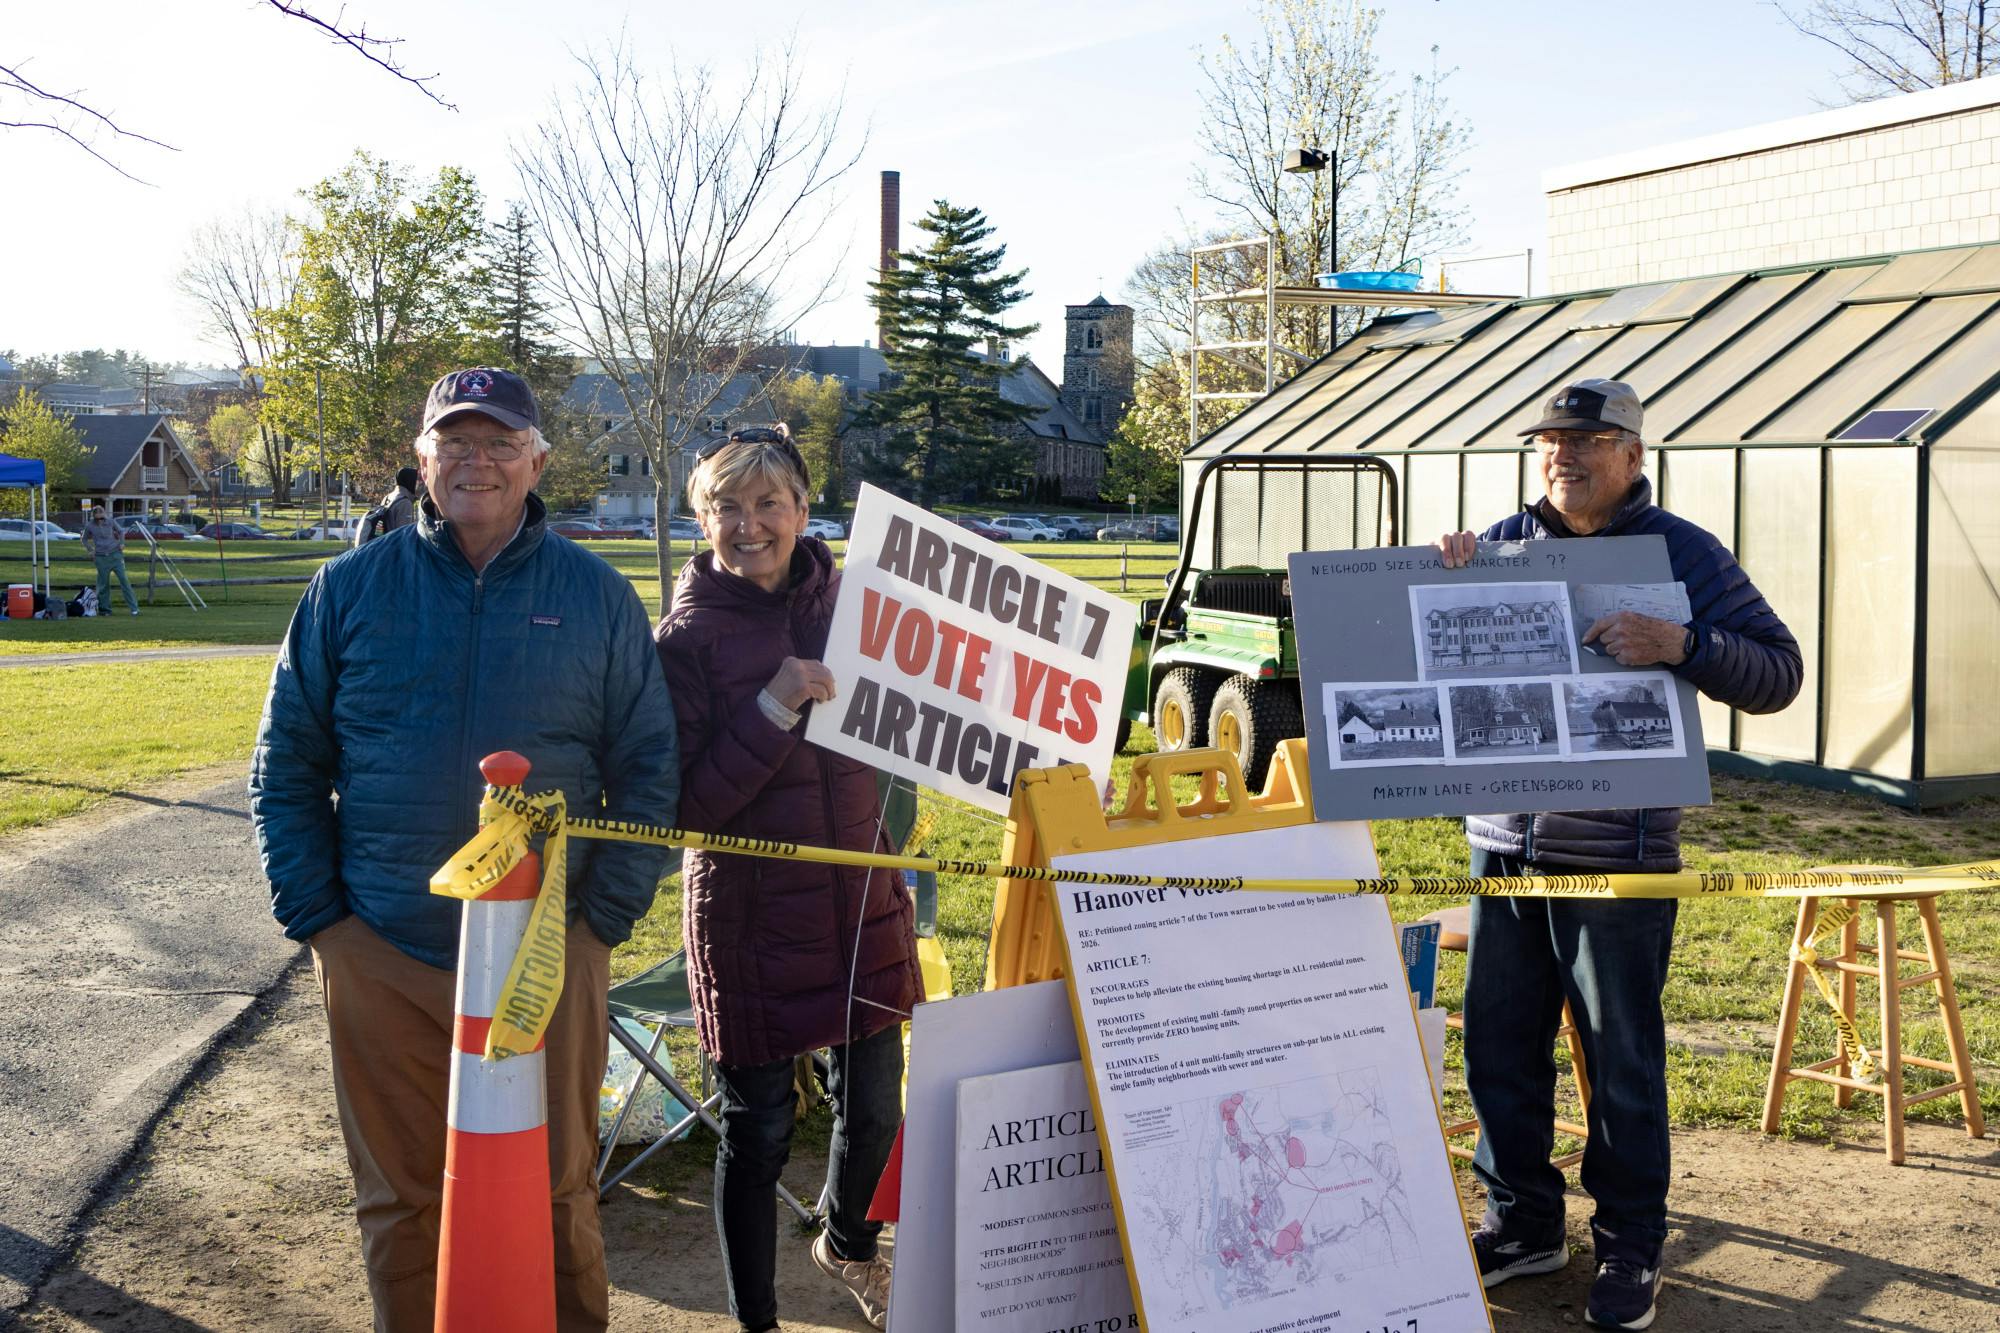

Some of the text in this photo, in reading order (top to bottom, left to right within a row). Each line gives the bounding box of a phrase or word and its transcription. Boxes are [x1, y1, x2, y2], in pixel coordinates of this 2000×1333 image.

[1386, 560, 1414, 571] SIZE
[1546, 553, 1566, 569] ??
[877, 514, 1110, 660] ARTICLE 7
[859, 587, 1102, 744] VOTE YES
[1373, 779, 1611, 800] MARTIN LANE GREENSBORO RD
[1072, 887, 1168, 914] Hanover
[1078, 929, 1093, 939] RE:
[1095, 923, 1133, 936] Petitioned
[1134, 920, 1158, 930] zoning
[1158, 916, 1180, 927] article
[1187, 913, 1195, 923] of
[1195, 912, 1207, 921] the
[1209, 911, 1229, 919] Town
[1230, 905, 1258, 916] warrant
[1266, 903, 1276, 911] be
[1277, 899, 1296, 909] voted
[1296, 899, 1306, 907] on
[1306, 897, 1315, 906] by
[1315, 893, 1337, 904] ballot
[1086, 953, 1151, 974] ARTICLE 7:
[1090, 979, 1150, 995] ENCOURAGES
[1092, 956, 1366, 1007] Duplexes to help alleviate the existing housing shortage in ALL residential zones.
[1096, 1012, 1146, 1027] PROMOTES
[1098, 1028, 1114, 1038] The
[1114, 1021, 1161, 1036] development
[1162, 1018, 1170, 1027] of
[1170, 1015, 1200, 1026] existing
[1246, 1002, 1268, 1013] zoned
[1267, 997, 1303, 1012] properties
[1303, 996, 1313, 1004] on
[1313, 992, 1333, 1002] sewer
[1334, 988, 1348, 998] and
[1347, 986, 1367, 995] water
[1368, 981, 1389, 992] which
[1101, 1018, 1240, 1049] currently provide ZERO housing units.
[1105, 1054, 1160, 1070] ELIMINATES
[1107, 1025, 1386, 1081] The introduction of 4 unit multi-family structures on sub-par lots in ALL existing
[1109, 1054, 1288, 1092] single family neighborhoods with sewer and water.
[982, 1110, 1097, 1150] ARTICL
[1027, 1209, 1070, 1223] COMMON
[1071, 1203, 1100, 1215] SENSE
[1007, 1241, 1039, 1254] RIGHT
[1040, 1239, 1053, 1248] IN
[1053, 1236, 1067, 1246] TO
[1068, 1233, 1087, 1243] THE
[1024, 1273, 1035, 1283] IN
[1036, 1264, 1096, 1281] AFFORDABLE
[1096, 1257, 1124, 1269] HOUSI
[980, 1293, 1079, 1319] WHAT DO YOU WANT?
[1296, 1309, 1342, 1328] development
[1095, 1317, 1122, 1333] TO
